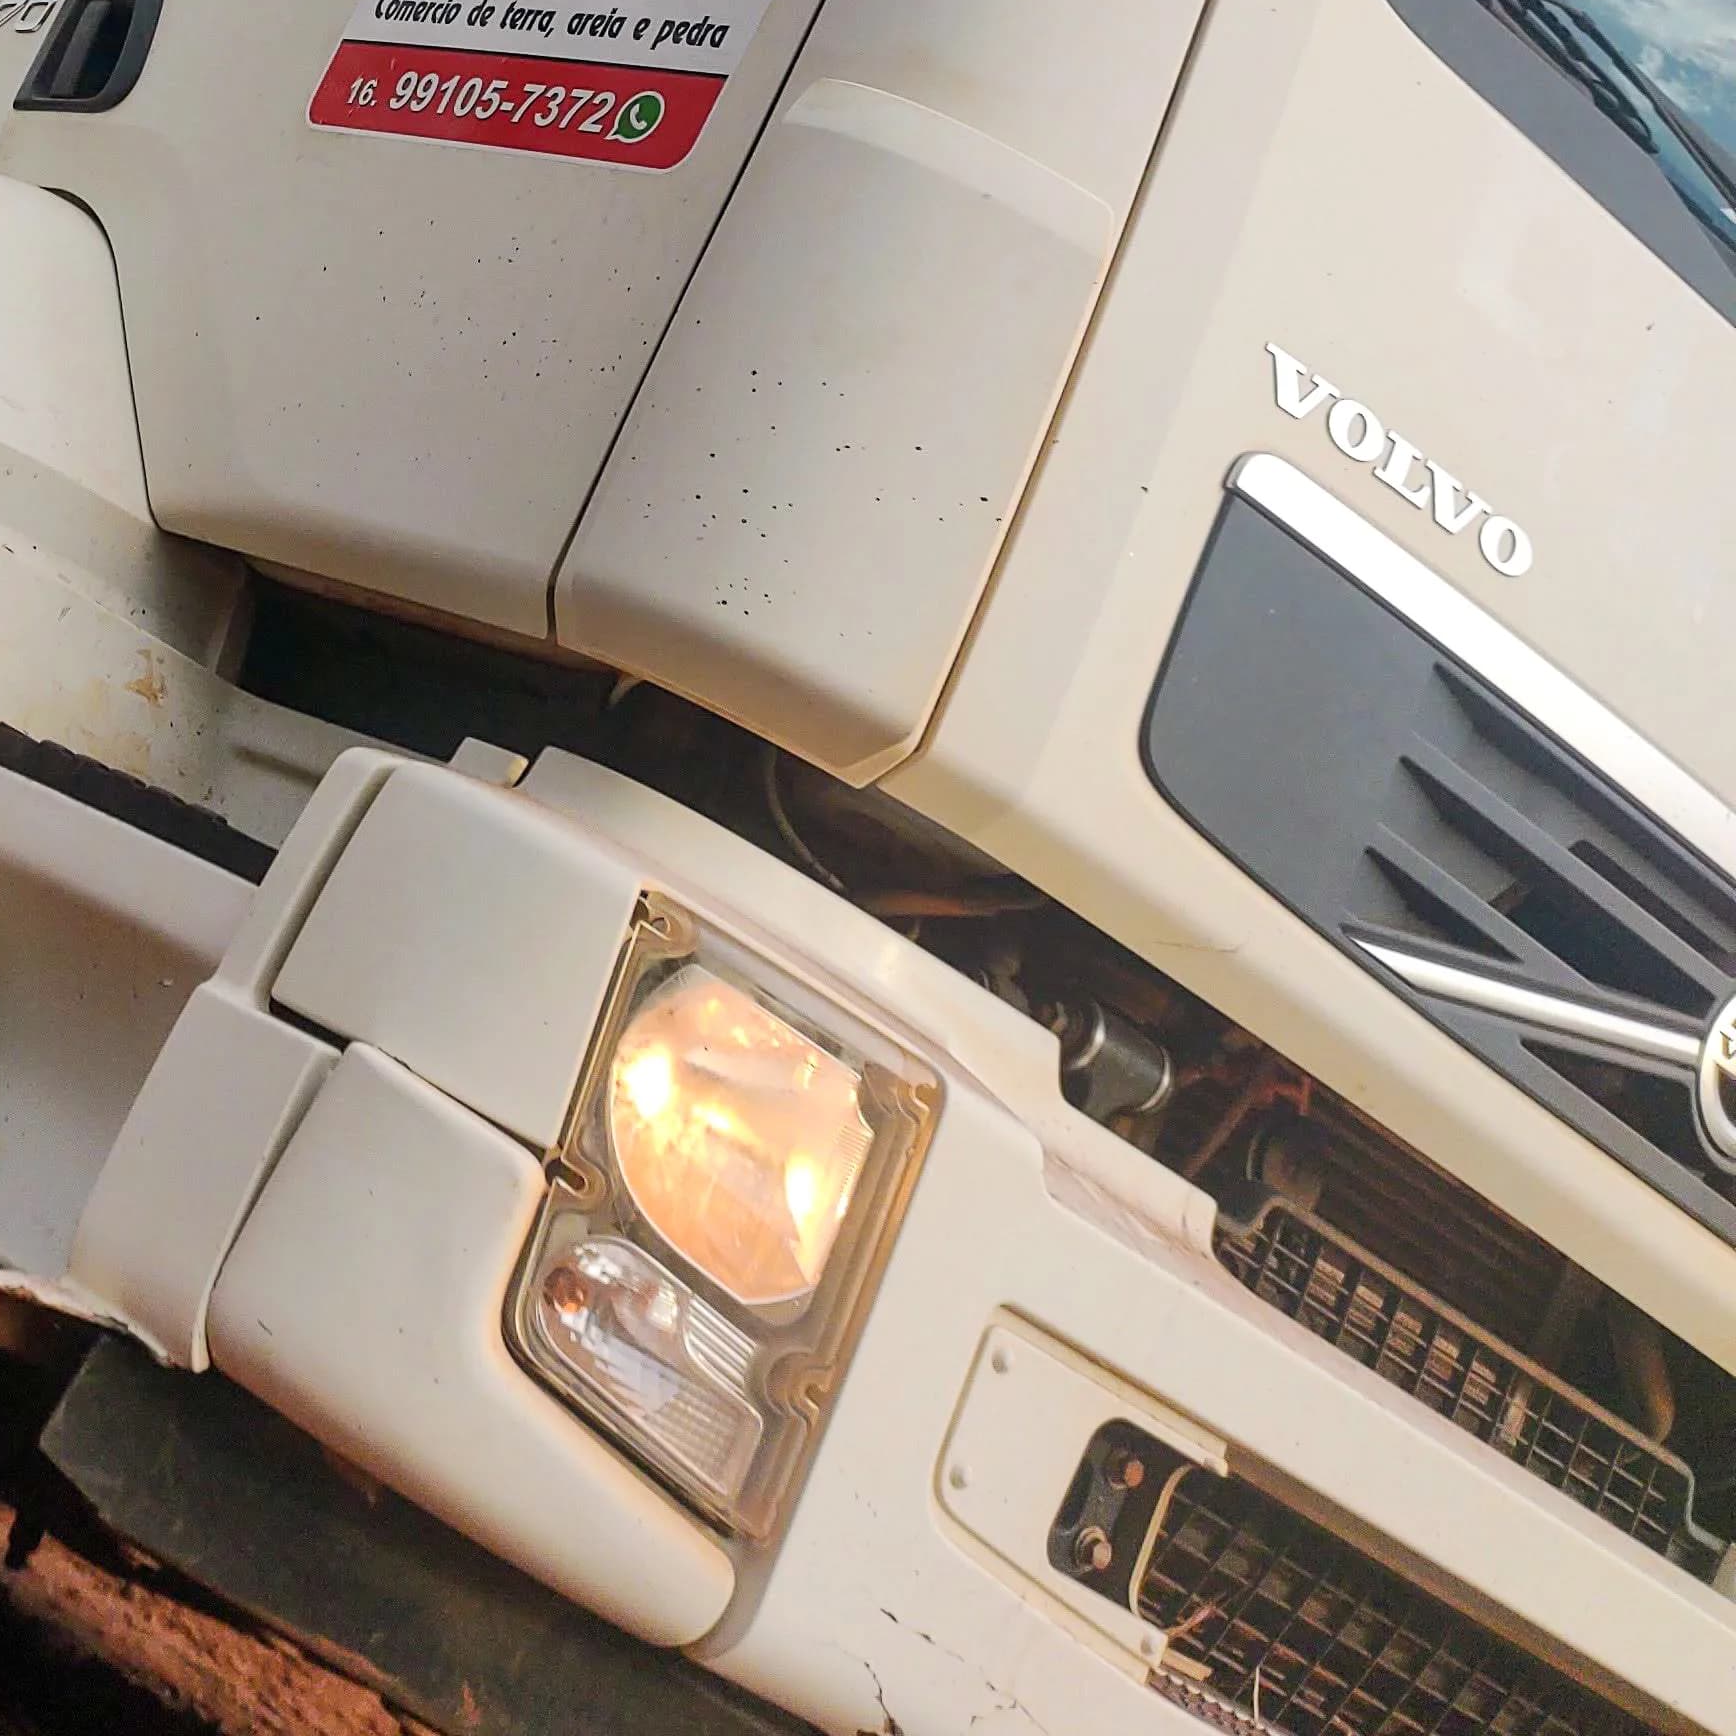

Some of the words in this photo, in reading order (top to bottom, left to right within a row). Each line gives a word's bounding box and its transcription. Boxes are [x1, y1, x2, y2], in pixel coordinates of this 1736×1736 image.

[500, 3, 557, 39] terra,
[567, 7, 626, 40] areia
[633, 19, 651, 41] e
[652, 17, 730, 50] pedra
[347, 76, 378, 108] 16.
[388, 71, 617, 133] 99105-7372
[1265, 341, 1534, 578] VOLVO
